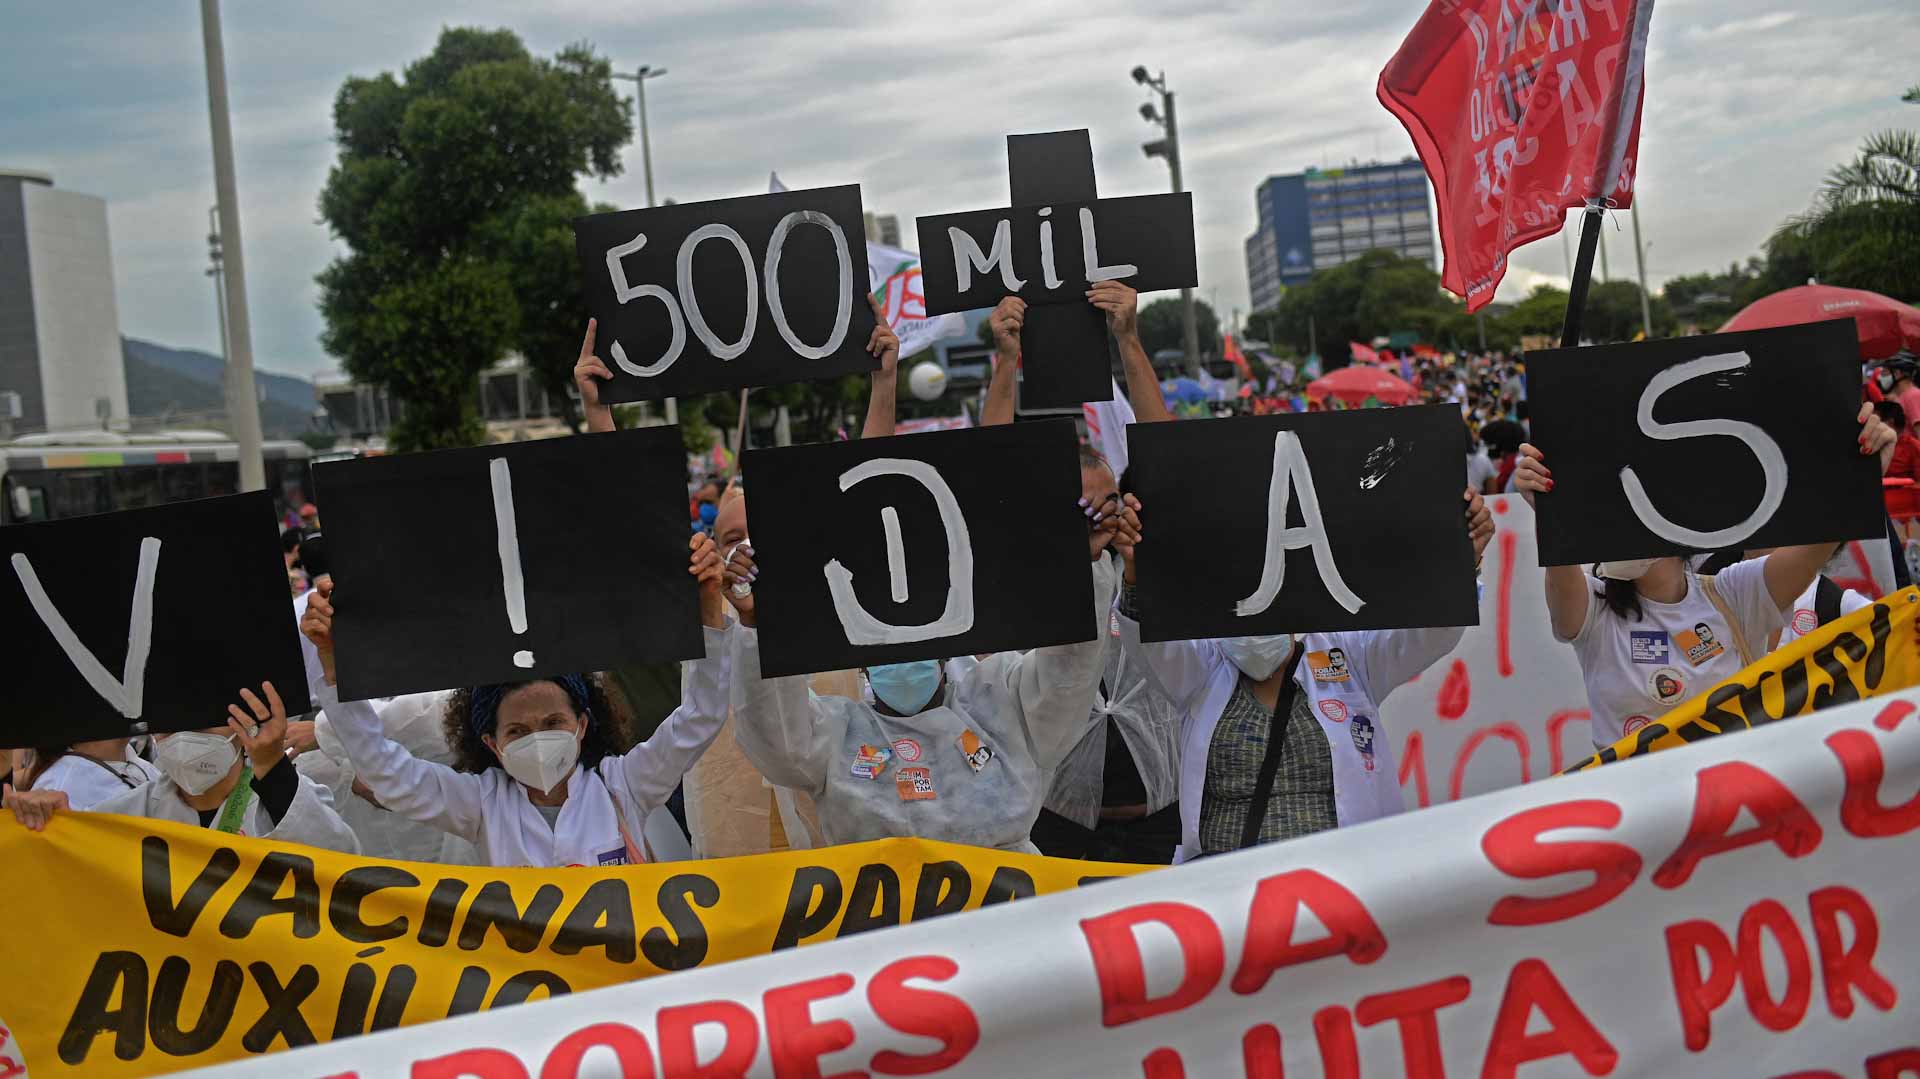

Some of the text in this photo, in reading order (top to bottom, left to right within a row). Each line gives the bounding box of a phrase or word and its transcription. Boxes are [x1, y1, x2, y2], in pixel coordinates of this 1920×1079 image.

[606, 210, 854, 378] 500
[10, 536, 162, 719] V
[1234, 430, 1367, 617] A
[1619, 350, 1788, 549] S
[142, 836, 720, 971] VACINAS
[330, 955, 981, 1079] ORES
[1080, 869, 1388, 1028] DA
[1142, 885, 1898, 1079] UTA POR
